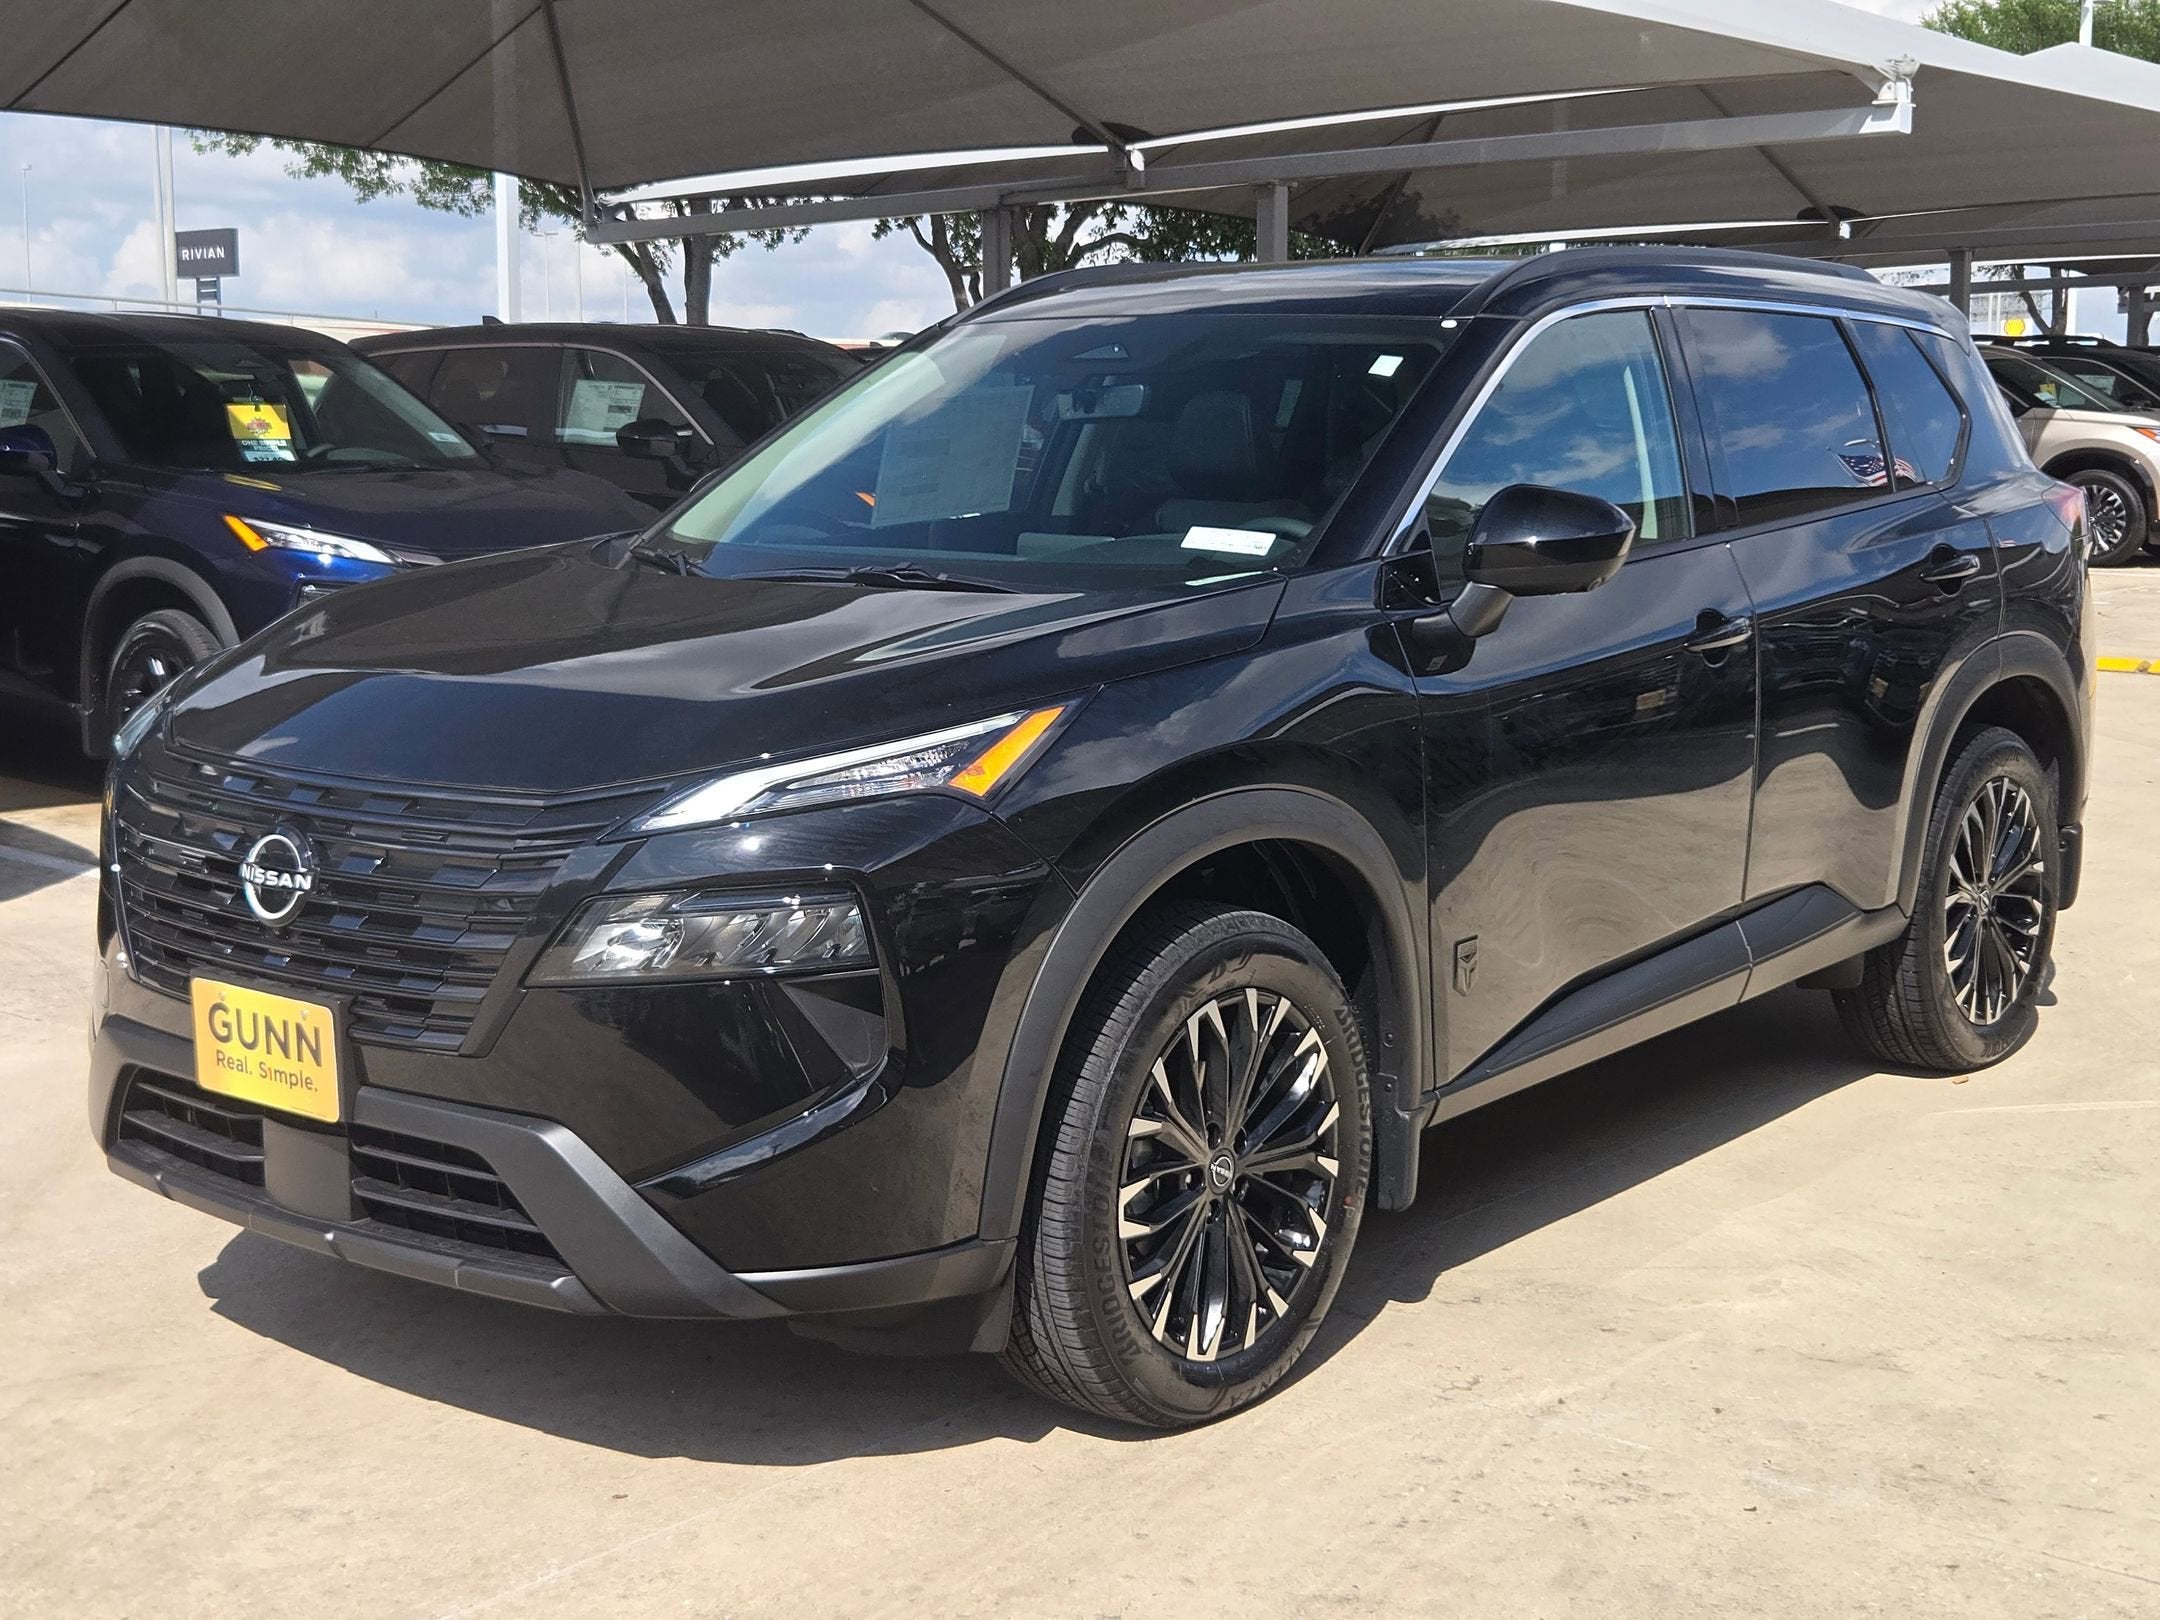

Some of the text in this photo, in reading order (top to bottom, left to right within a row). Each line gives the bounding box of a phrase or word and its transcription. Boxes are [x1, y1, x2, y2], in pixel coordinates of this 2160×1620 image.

[181, 246, 226, 261] RIVIAN
[239, 863, 312, 890] NISSAN
[208, 1002, 322, 1068] GUNN
[216, 1049, 253, 1075] Real.
